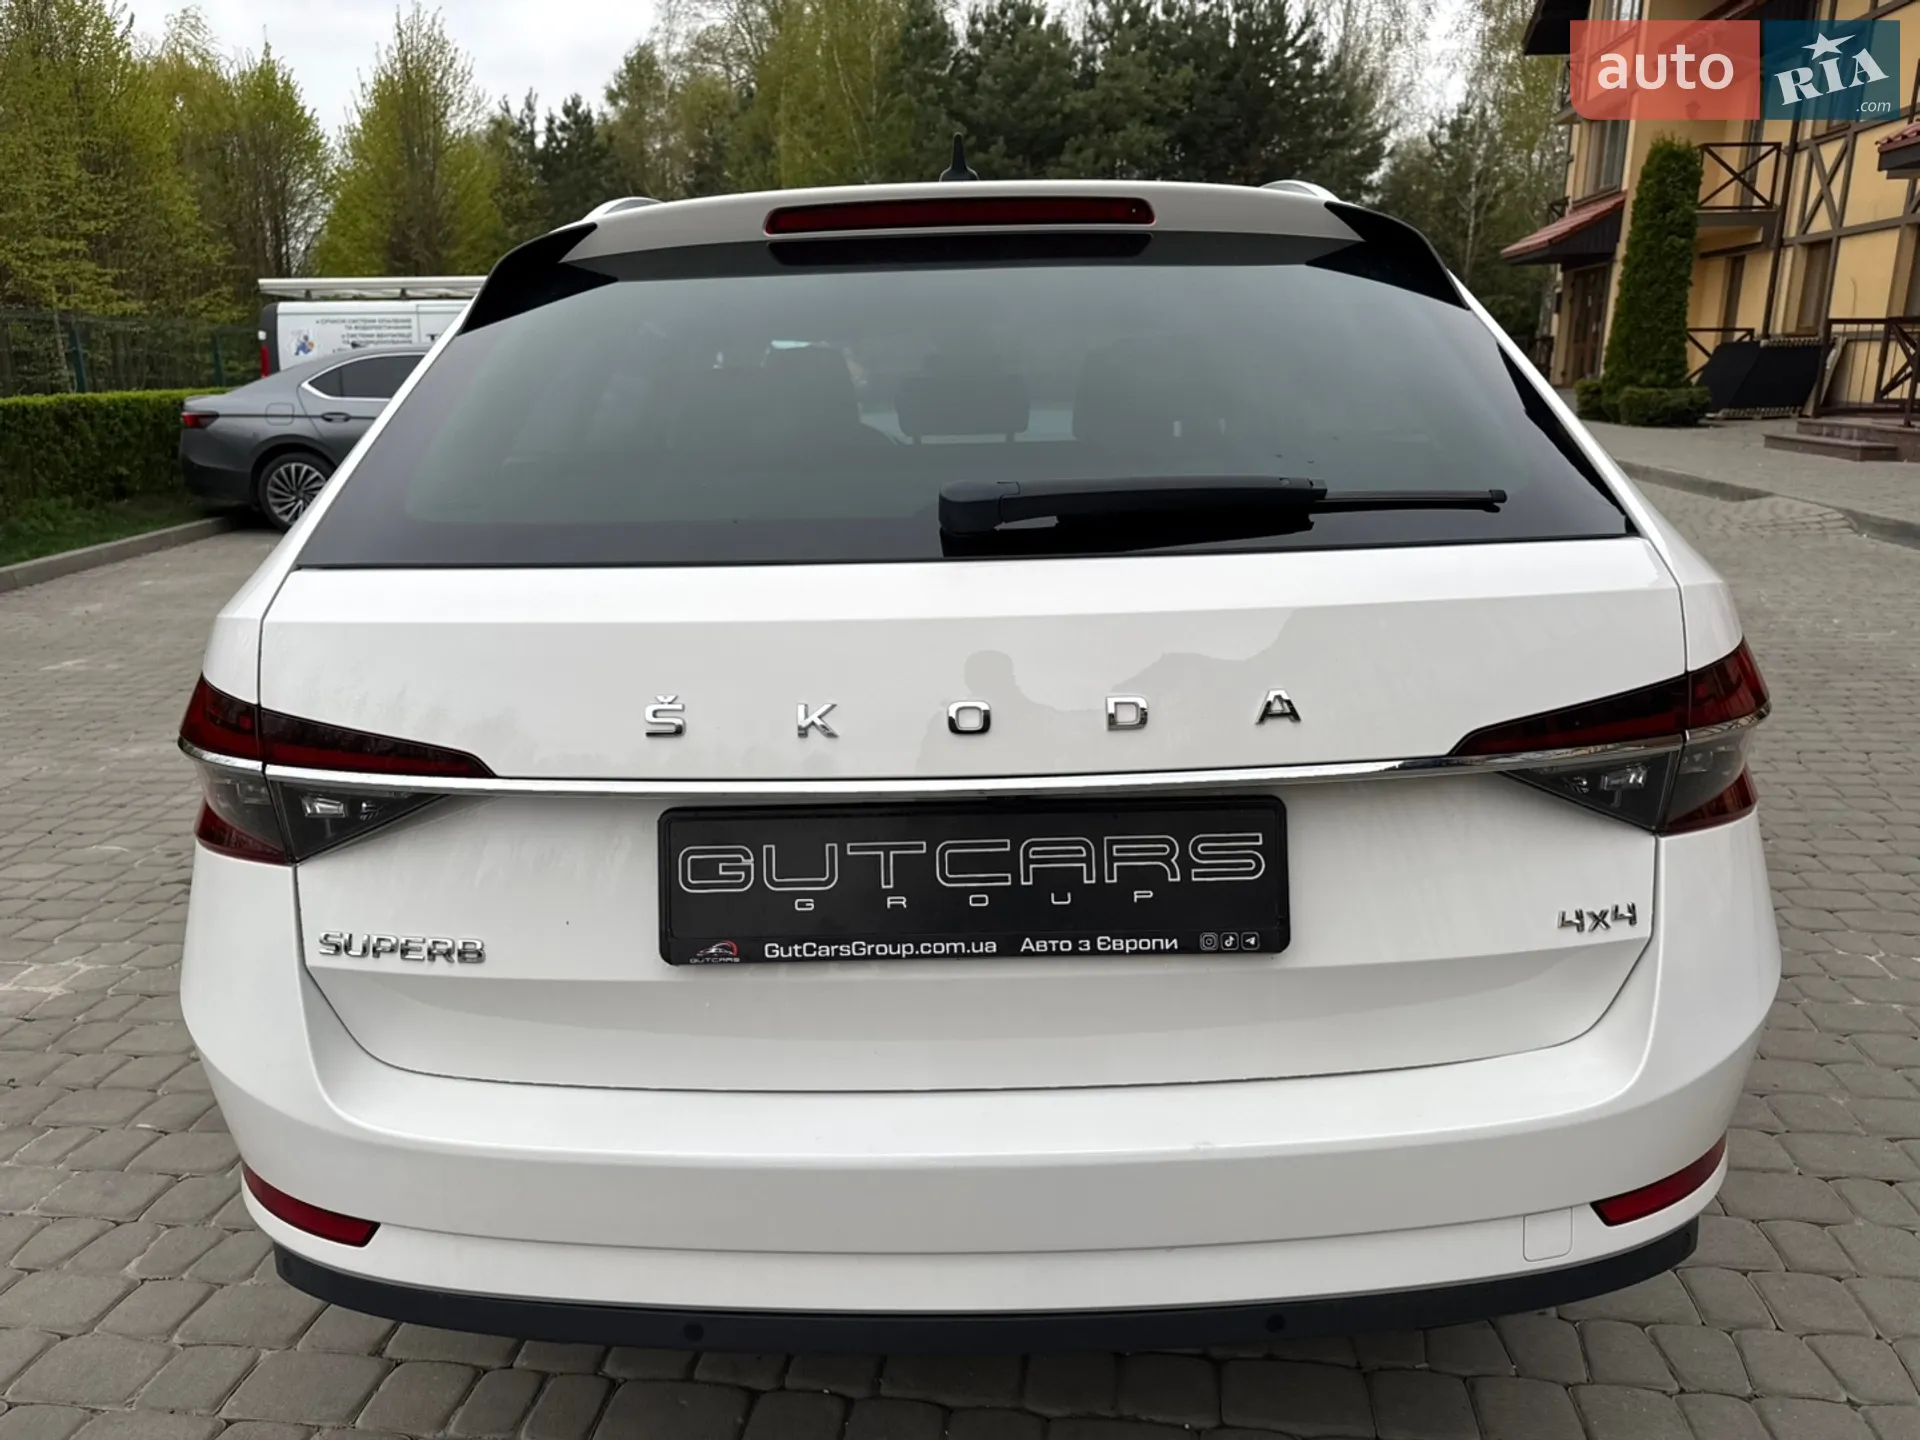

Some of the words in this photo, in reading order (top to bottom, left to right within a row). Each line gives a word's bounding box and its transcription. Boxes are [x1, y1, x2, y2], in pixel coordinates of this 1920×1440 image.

[645, 689, 1302, 738] ŠKODA
[678, 833, 1266, 893] GUTCARS
[794, 890, 1154, 911] GROUP
[318, 931, 487, 965] SUPERB
[764, 940, 997, 958] GutCarsGroup.com.ua
[1020, 937, 1072, 953] Авто
[1096, 935, 1179, 954] Європи
